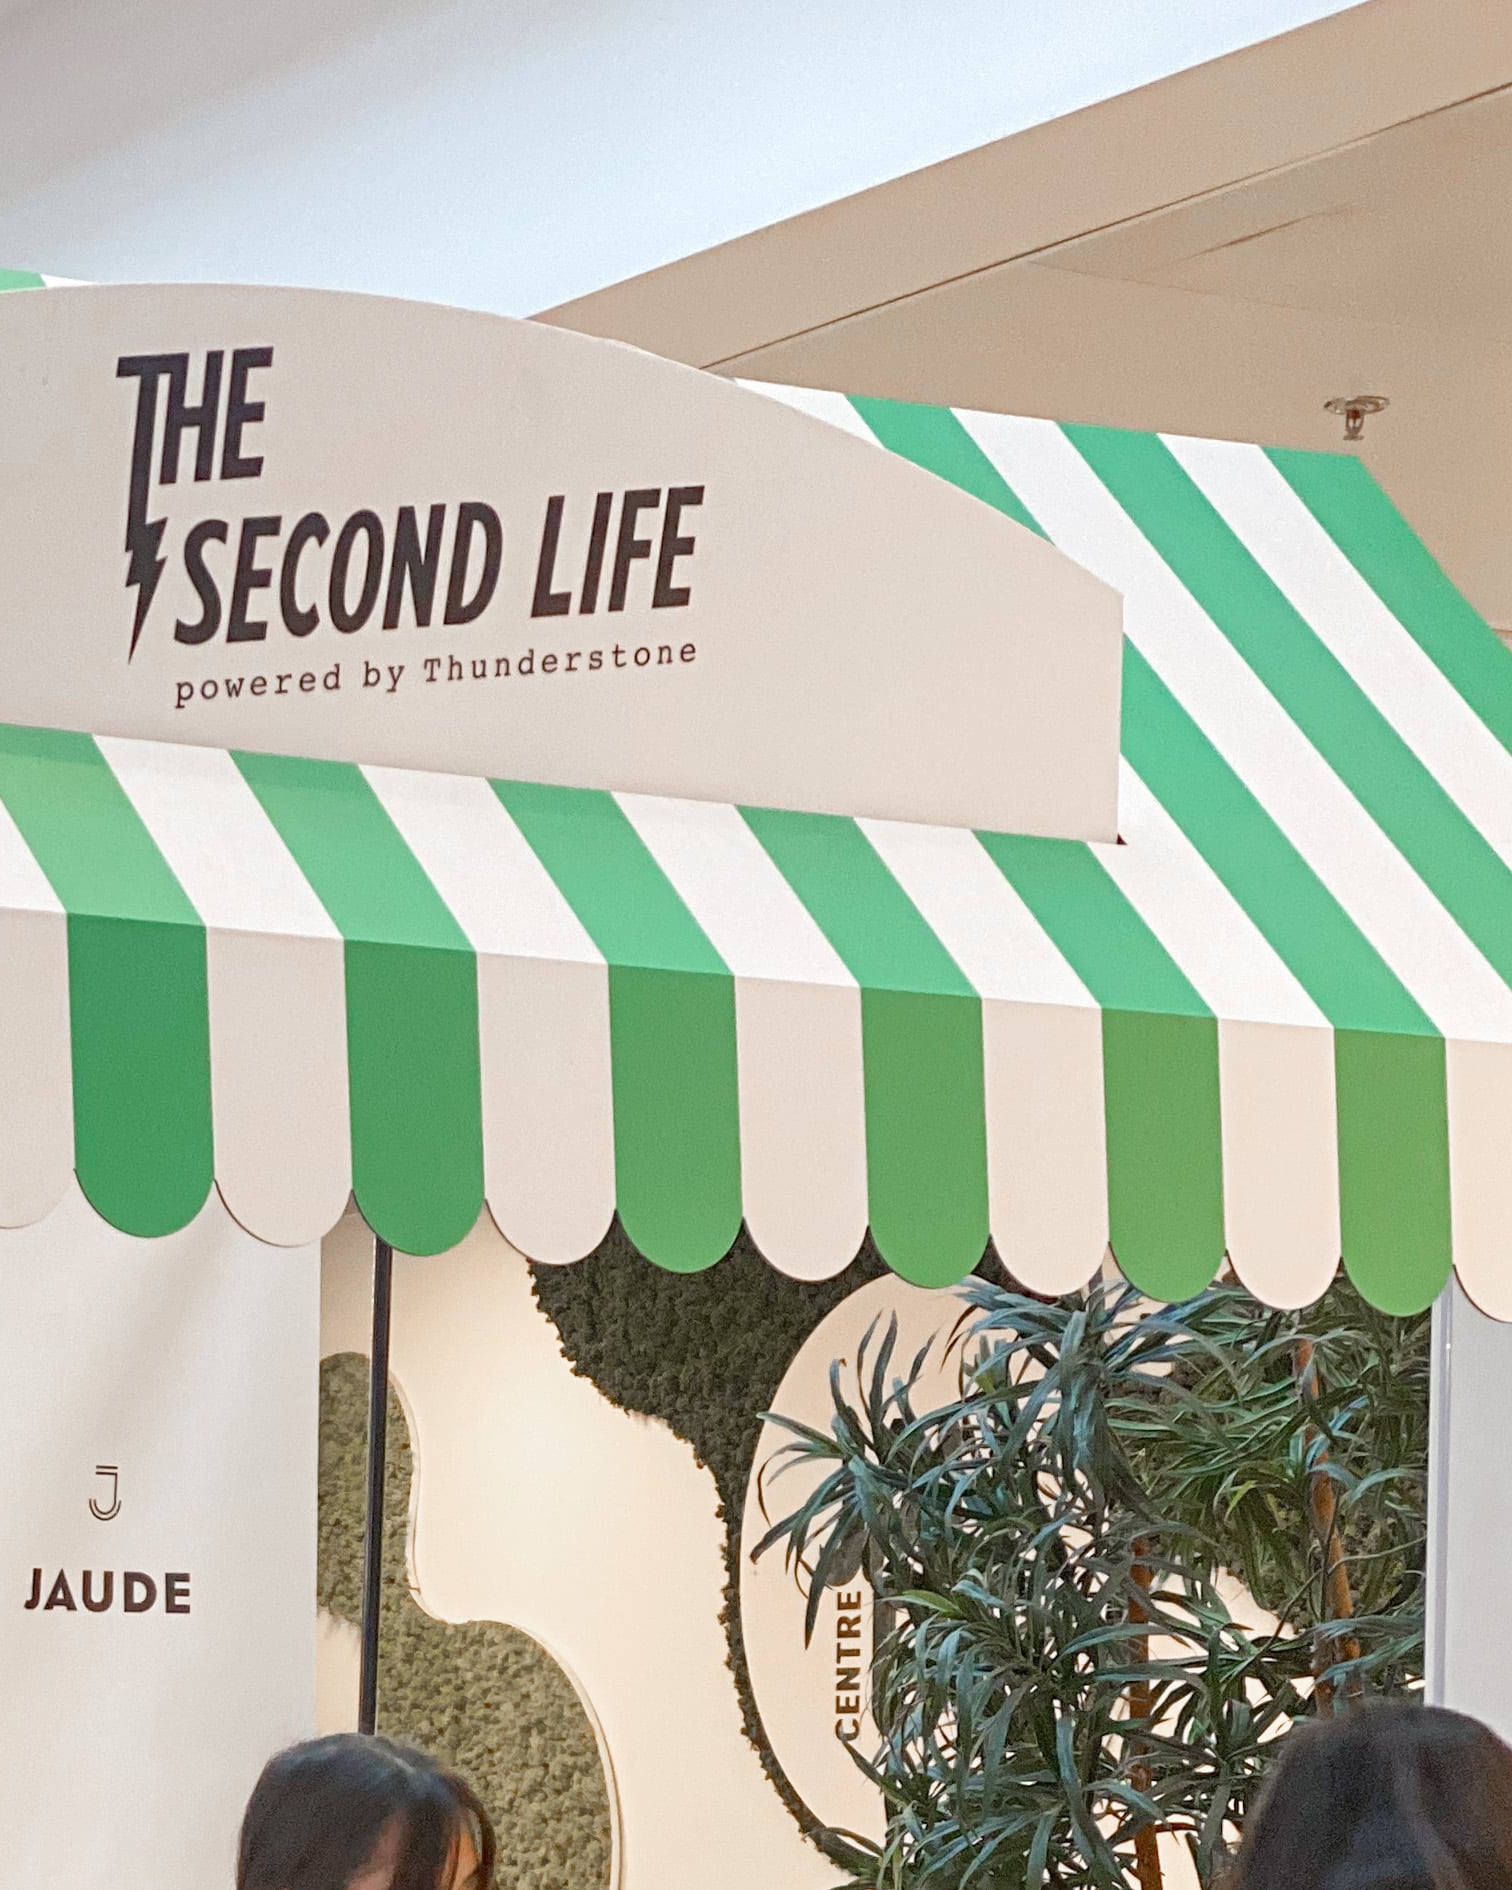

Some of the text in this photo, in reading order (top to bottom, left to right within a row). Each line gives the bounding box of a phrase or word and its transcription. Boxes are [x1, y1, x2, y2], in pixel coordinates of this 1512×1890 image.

[174, 486, 705, 645] SECOND LIFE
[176, 640, 698, 709] powered by Thunderstone
[24, 1568, 190, 1613] JAUDE
[835, 1591, 862, 1741] CENTRE
